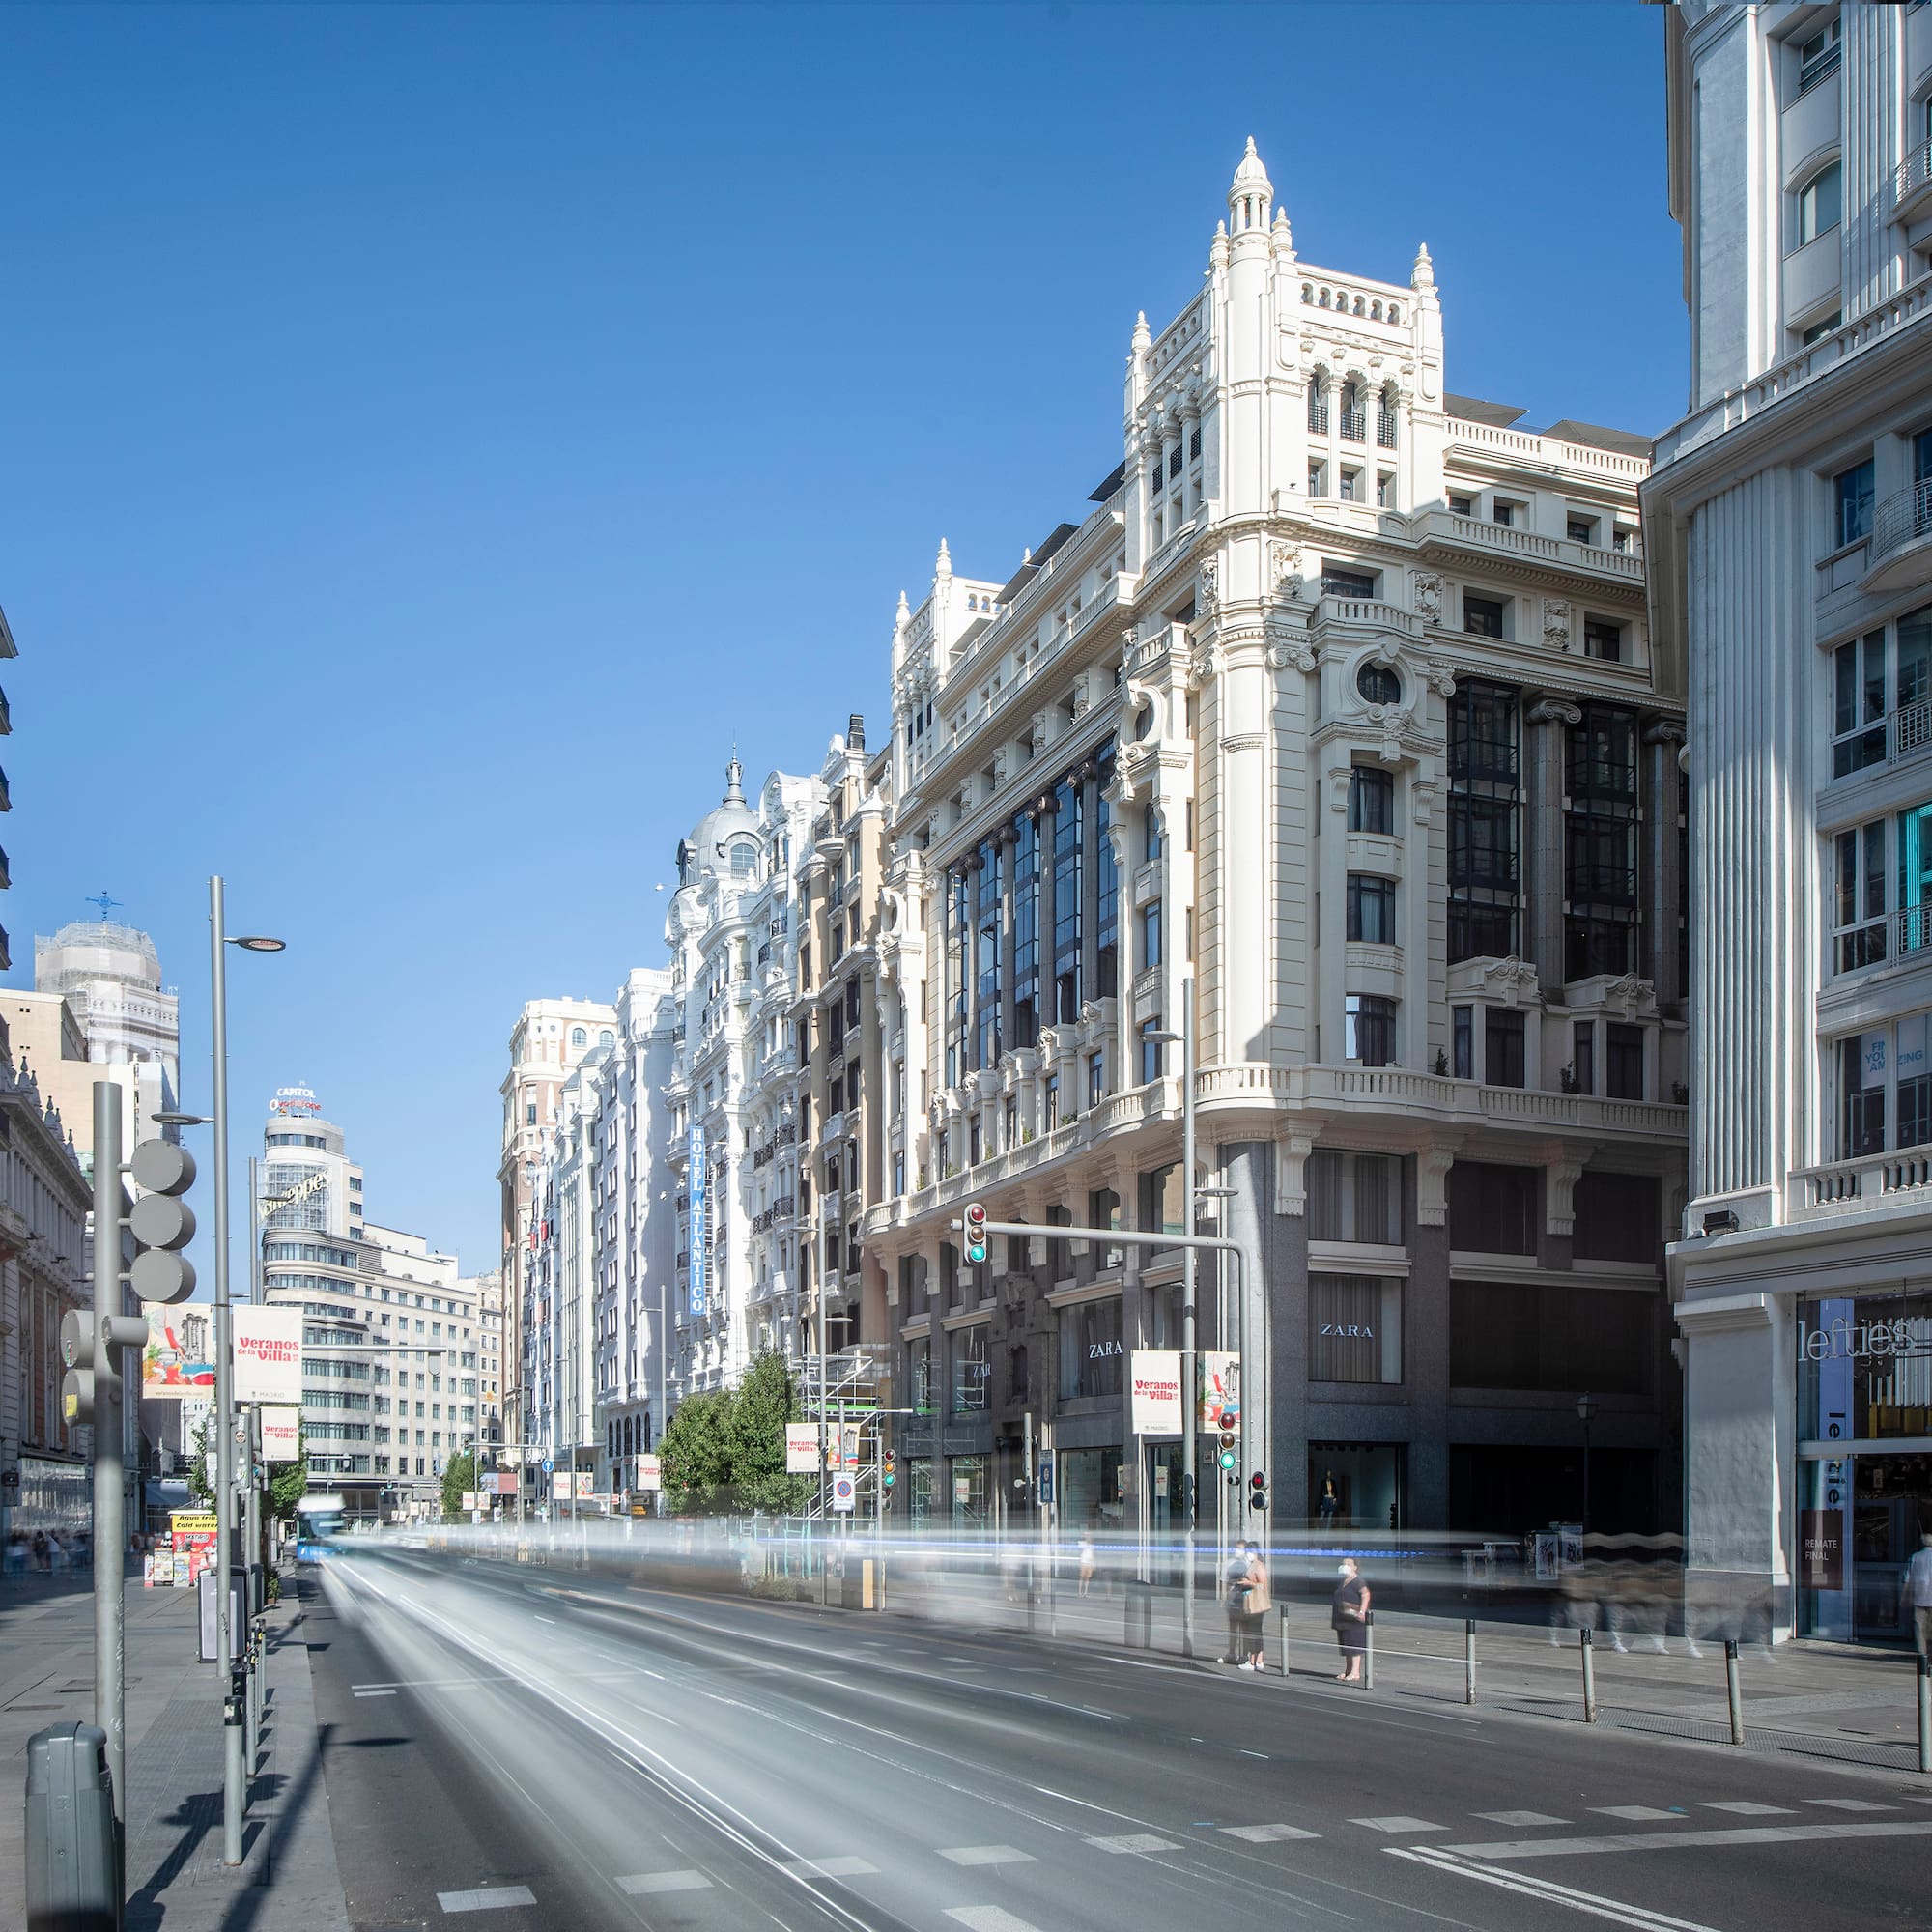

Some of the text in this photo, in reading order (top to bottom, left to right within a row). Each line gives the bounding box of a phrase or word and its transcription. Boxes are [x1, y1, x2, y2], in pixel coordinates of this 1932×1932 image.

[277, 1088, 316, 1098] CAPITOL
[692, 1128, 703, 1312] HOTEL ATLANTICO
[1321, 1323, 1374, 1338] ZARA
[239, 1337, 299, 1350] Veranos
[1797, 1318, 1914, 1362] lefties
[1089, 1340, 1123, 1359] ZARA
[257, 1350, 292, 1362] Villa
[973, 1362, 991, 1378] ZAR
[1135, 1380, 1179, 1390] Veranos
[1149, 1391, 1173, 1400] Villa
[1804, 1539, 1837, 1548] REMATE
[1804, 1550, 1829, 1561] FINAL
